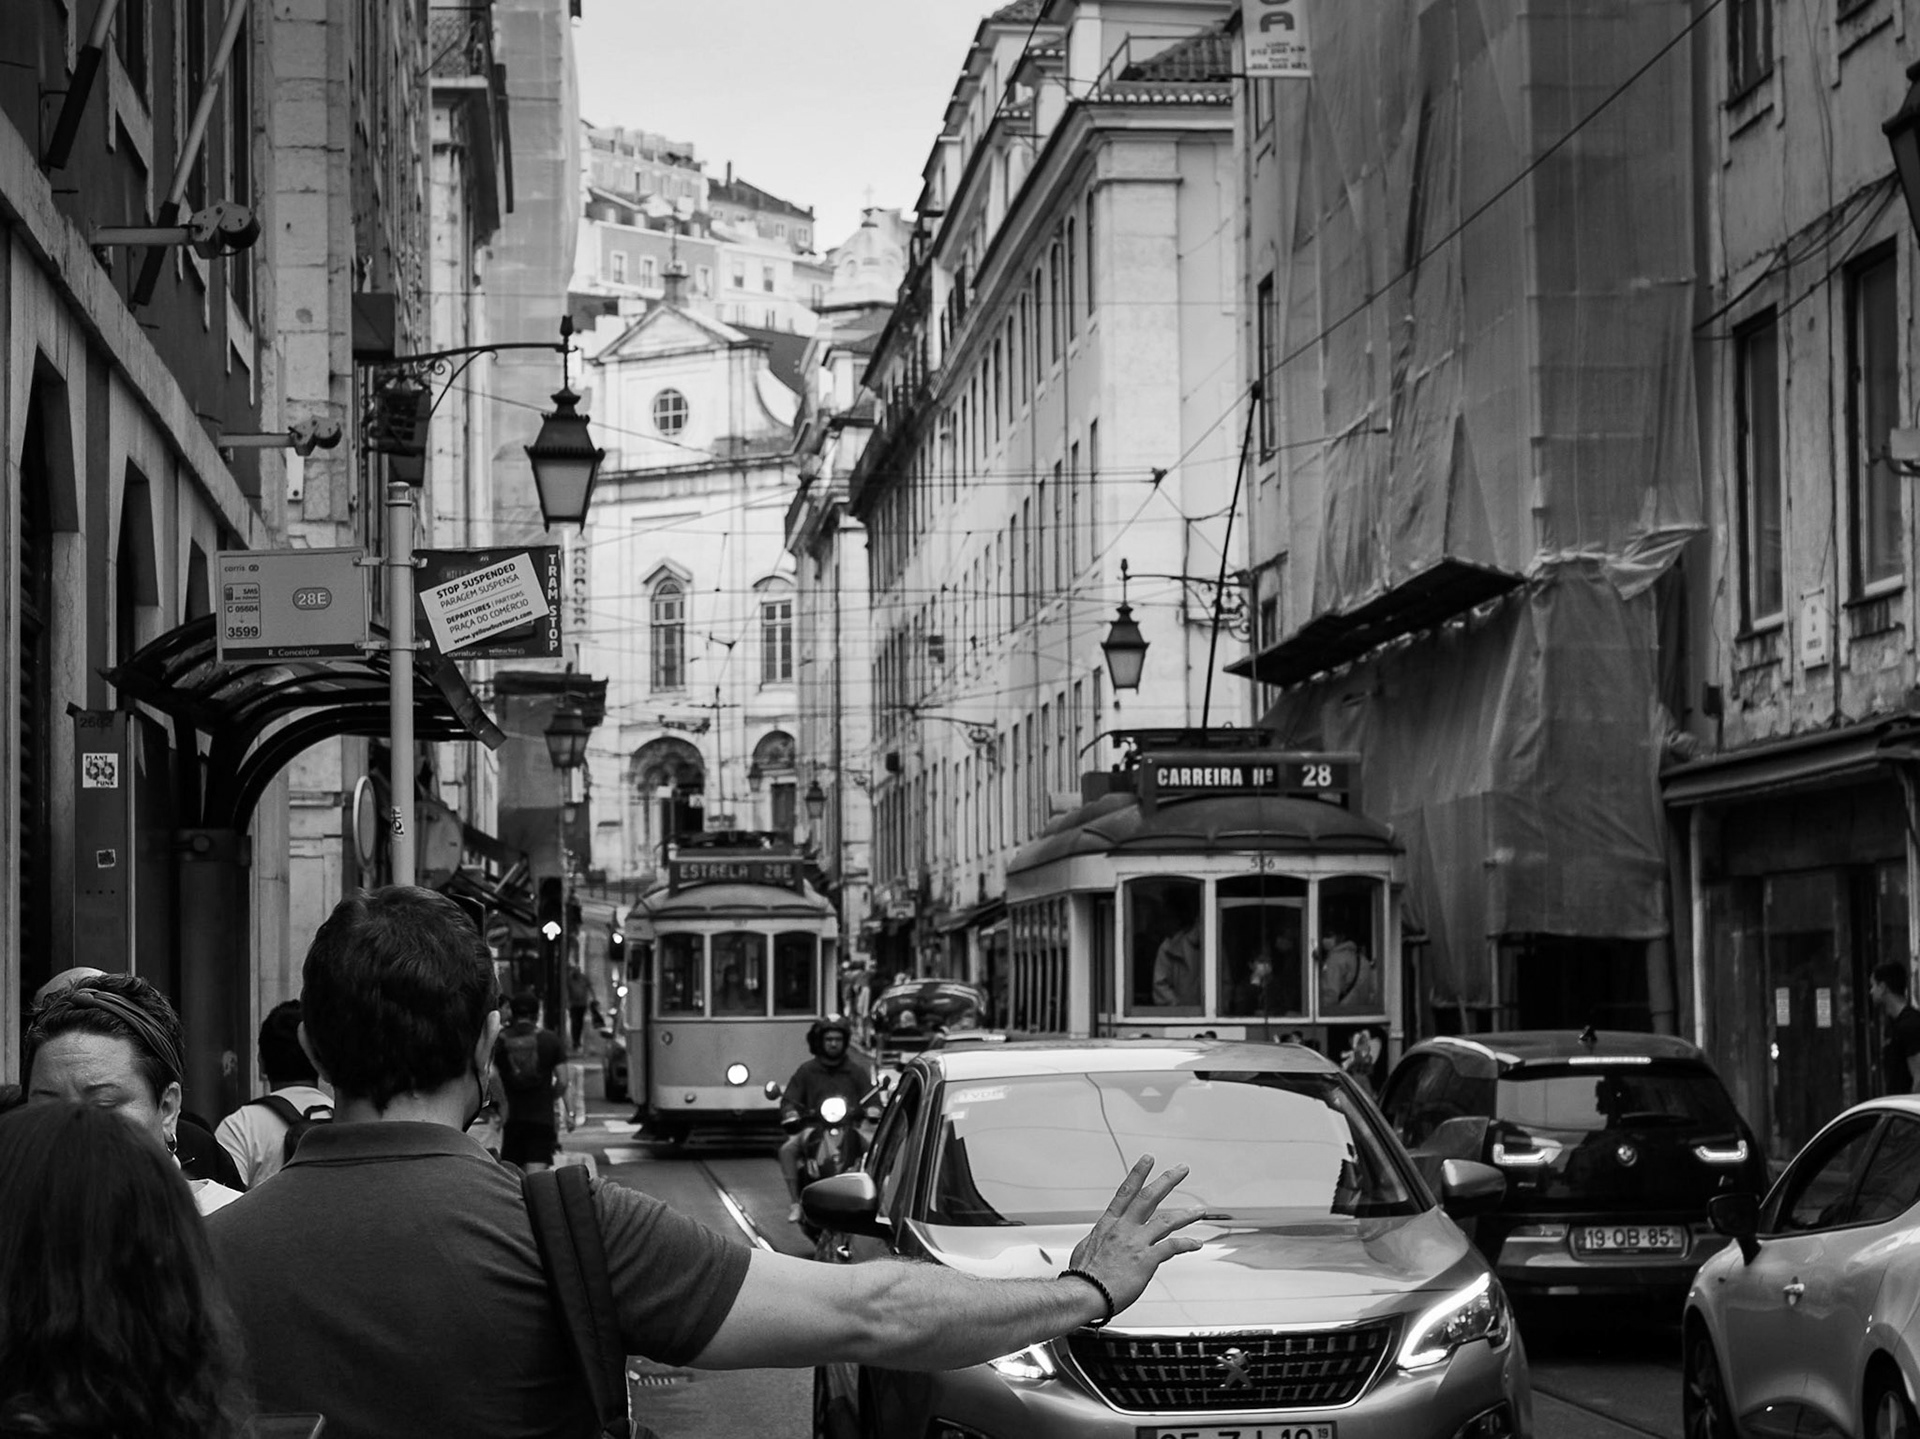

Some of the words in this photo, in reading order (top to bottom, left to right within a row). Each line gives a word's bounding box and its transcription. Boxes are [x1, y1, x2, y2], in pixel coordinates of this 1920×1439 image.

[224, 564, 245, 573] carris
[548, 554, 558, 600] TRAM
[436, 583, 460, 599] STOP
[461, 562, 516, 590] SUSPENDED
[440, 588, 478, 608] PARAGEM
[478, 573, 520, 595] SUSPENSA
[227, 605, 234, 614] C
[297, 591, 328, 606] 28E
[446, 602, 492, 625] DEPARTURES
[495, 590, 525, 606] PARTIDAS
[449, 618, 476, 634] PRAÇA
[476, 613, 489, 624] DO
[489, 598, 529, 619] COMÉRCIO
[453, 610, 533, 644] www.yellowbustours.com
[227, 625, 259, 638] 3599
[548, 605, 558, 651] STOP
[278, 647, 320, 657] Conceição
[1157, 767, 1243, 786] CARREIRA
[1301, 765, 1332, 787] 28
[679, 863, 749, 879] ESTRELA
[764, 864, 792, 878] 28E
[1250, 856, 1275, 870] 56
